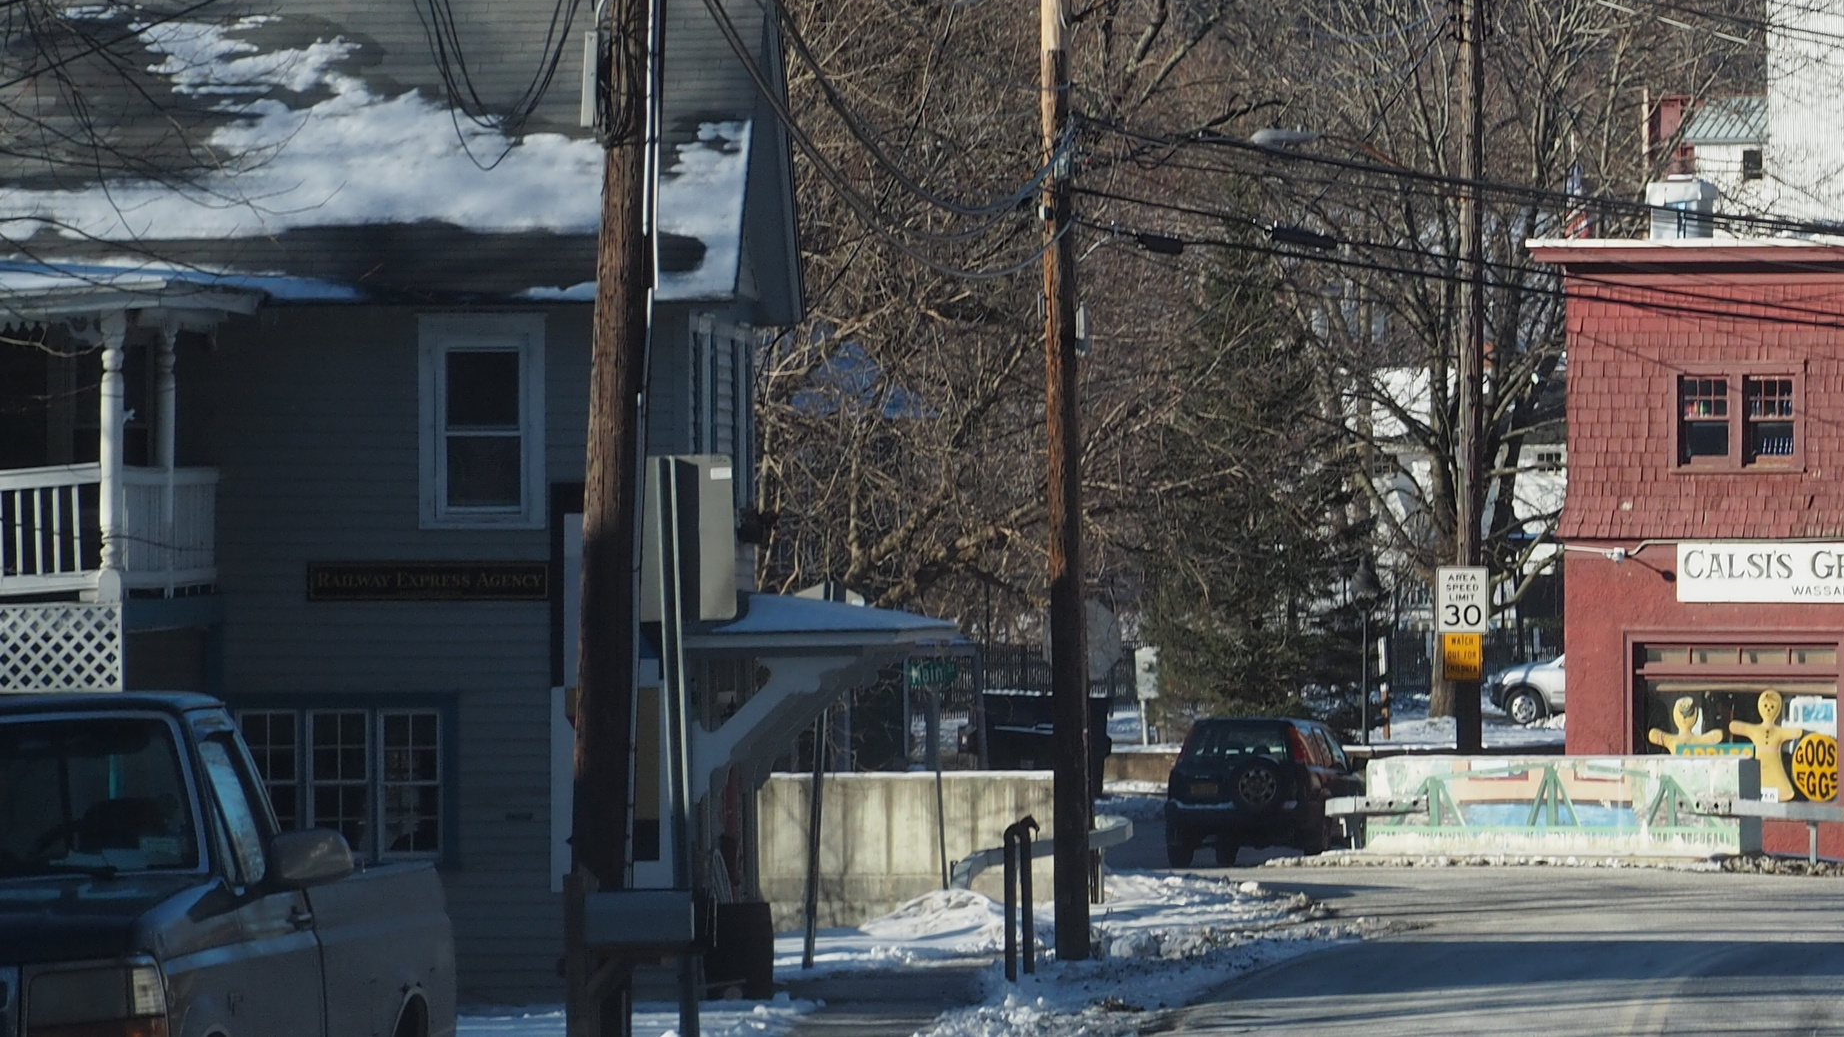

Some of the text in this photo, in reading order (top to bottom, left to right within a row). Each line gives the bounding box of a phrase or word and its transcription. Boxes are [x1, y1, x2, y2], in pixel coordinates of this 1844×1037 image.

[1683, 549, 1794, 580] CALSI'S
[317, 571, 542, 588] RAILWAY EXPRESS AGENCY
[1448, 574, 1477, 582] AREA
[1446, 584, 1479, 592] SPEED
[1449, 594, 1475, 602] LIMIT
[1443, 604, 1482, 626] 30
[1451, 636, 1474, 646] WATCH
[1447, 650, 1477, 660] OUT FOR
[911, 664, 943, 684] Main
[1795, 739, 1836, 767] GOOS
